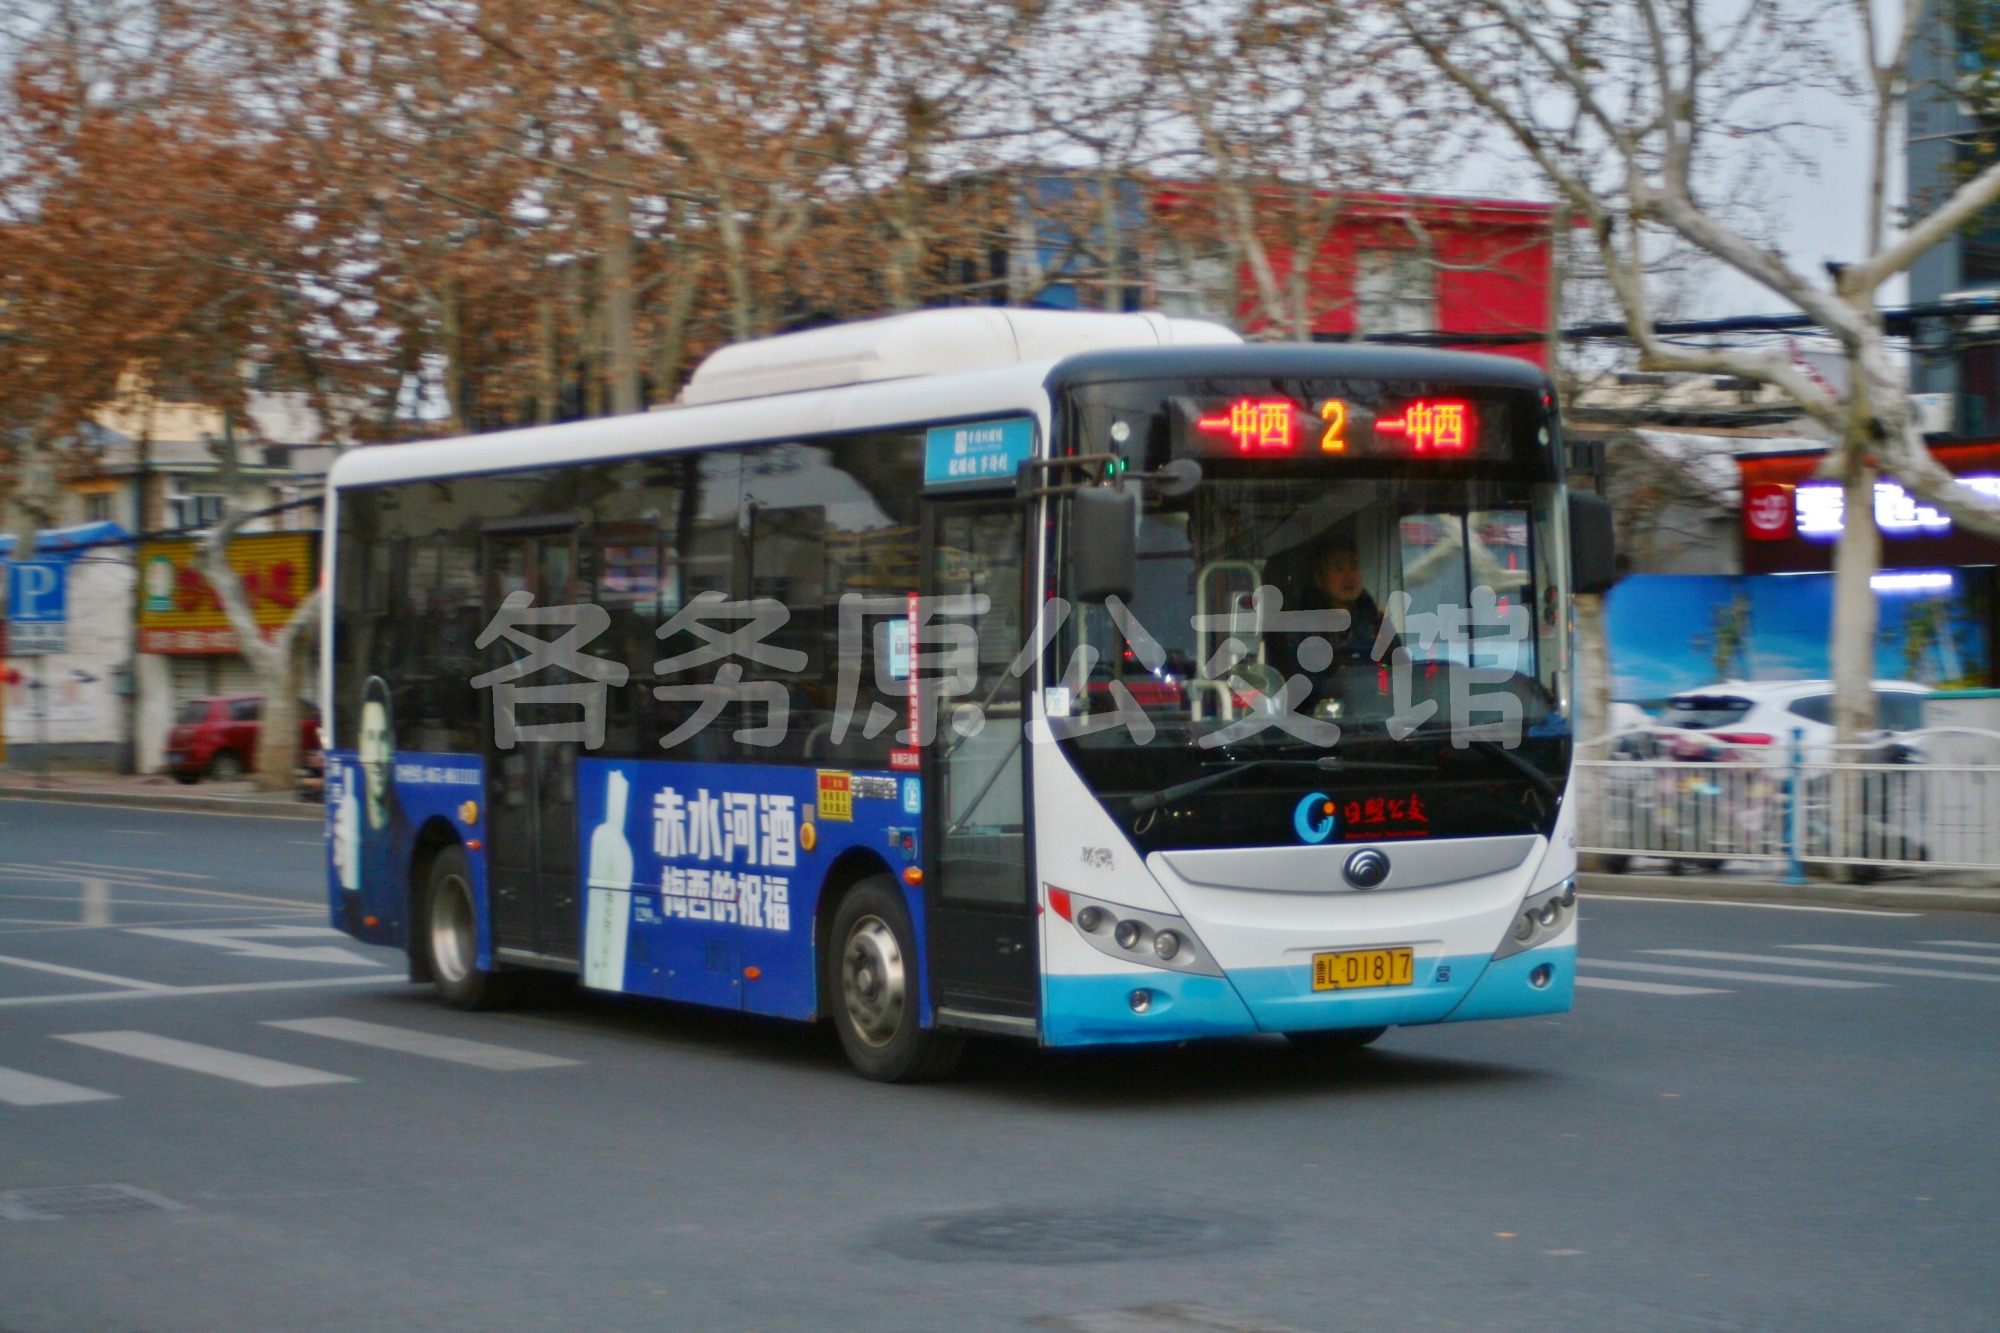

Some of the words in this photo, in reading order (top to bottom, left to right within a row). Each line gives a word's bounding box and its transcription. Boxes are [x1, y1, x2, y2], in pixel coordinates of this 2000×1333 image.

[1199, 399, 1291, 450] 一中西
[1321, 400, 1345, 449] 2
[1376, 401, 1465, 449] 一中西
[17, 564, 58, 618] P
[653, 786, 796, 866] 赤水河酒
[1344, 792, 1429, 824] 日照公交
[661, 865, 790, 931] 梅西的祝福
